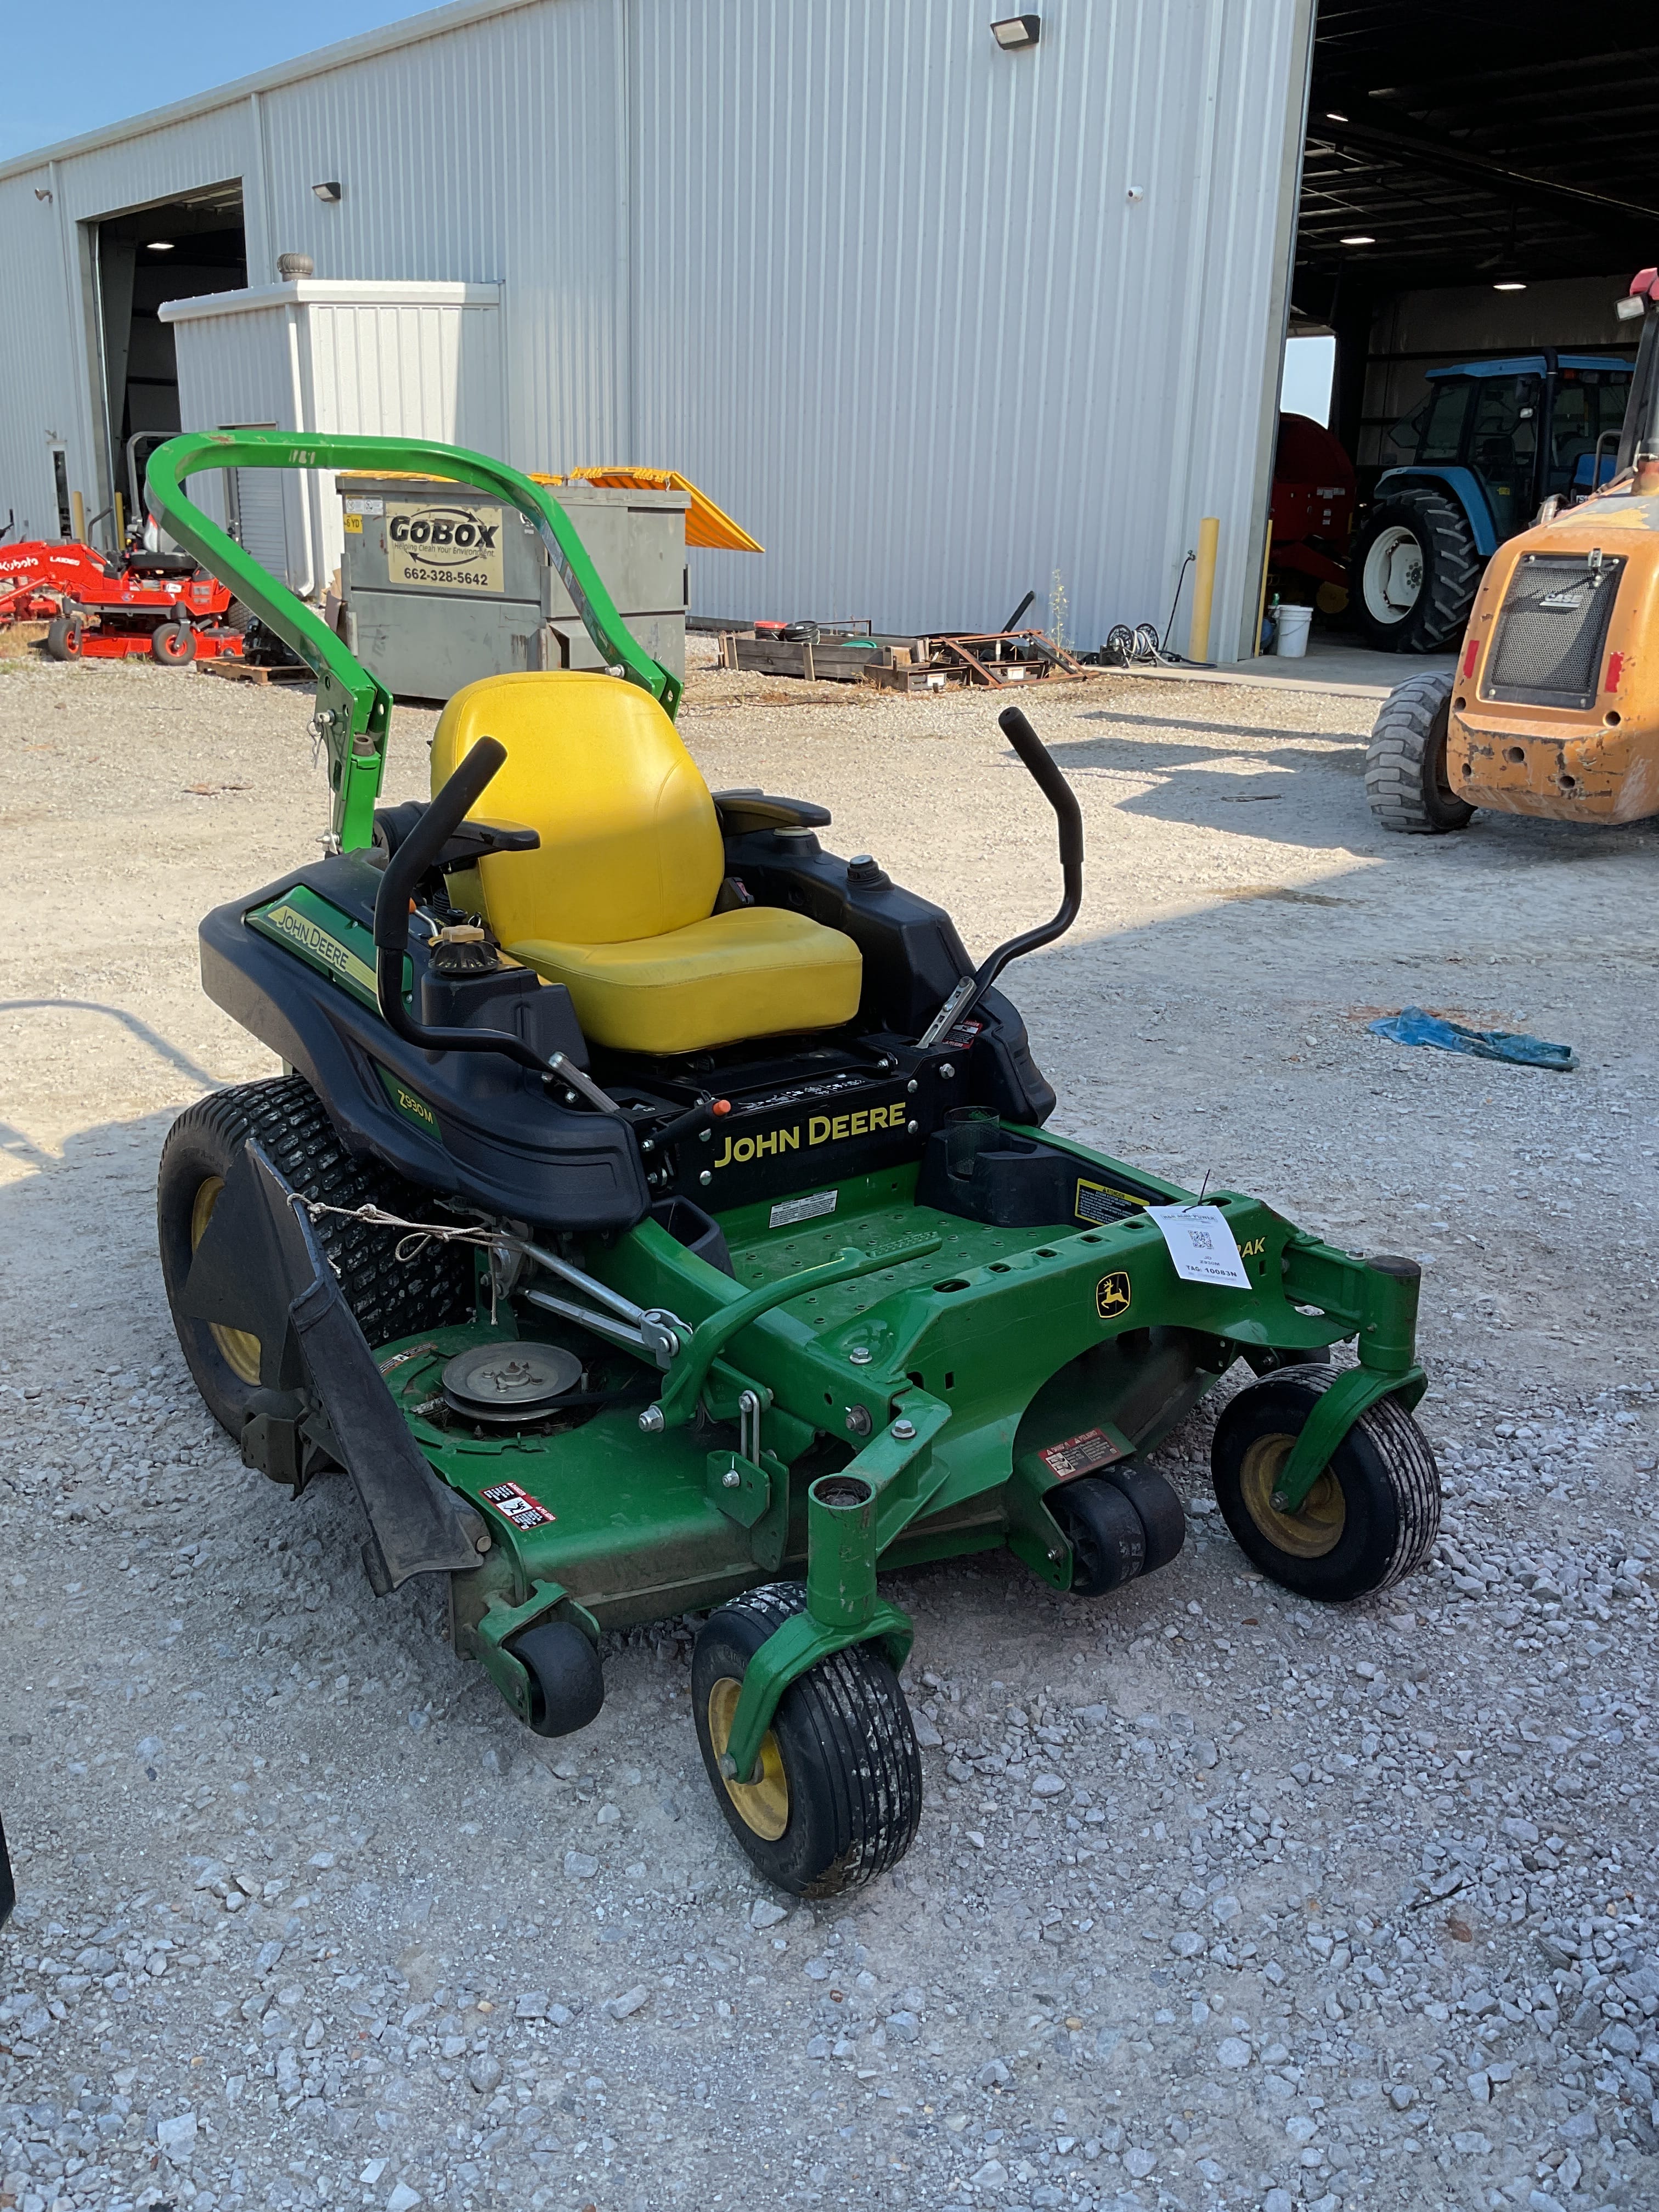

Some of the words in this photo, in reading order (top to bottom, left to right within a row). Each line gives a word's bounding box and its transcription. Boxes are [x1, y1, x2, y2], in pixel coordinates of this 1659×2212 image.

[352, 518, 359, 528] YD
[390, 515, 499, 549] GOBOX
[394, 543, 417, 551] Helping
[0, 556, 38, 571] Kubota
[404, 567, 488, 586] 662-328-5642
[1544, 592, 1583, 603] CASE
[278, 910, 309, 942] JOHN
[310, 928, 349, 970] DEERE
[398, 1089, 433, 1125] Z930M
[714, 1126, 799, 1167] JOHN
[809, 1102, 906, 1146] DEERE
[1205, 1268, 1237, 1277] 10083N
